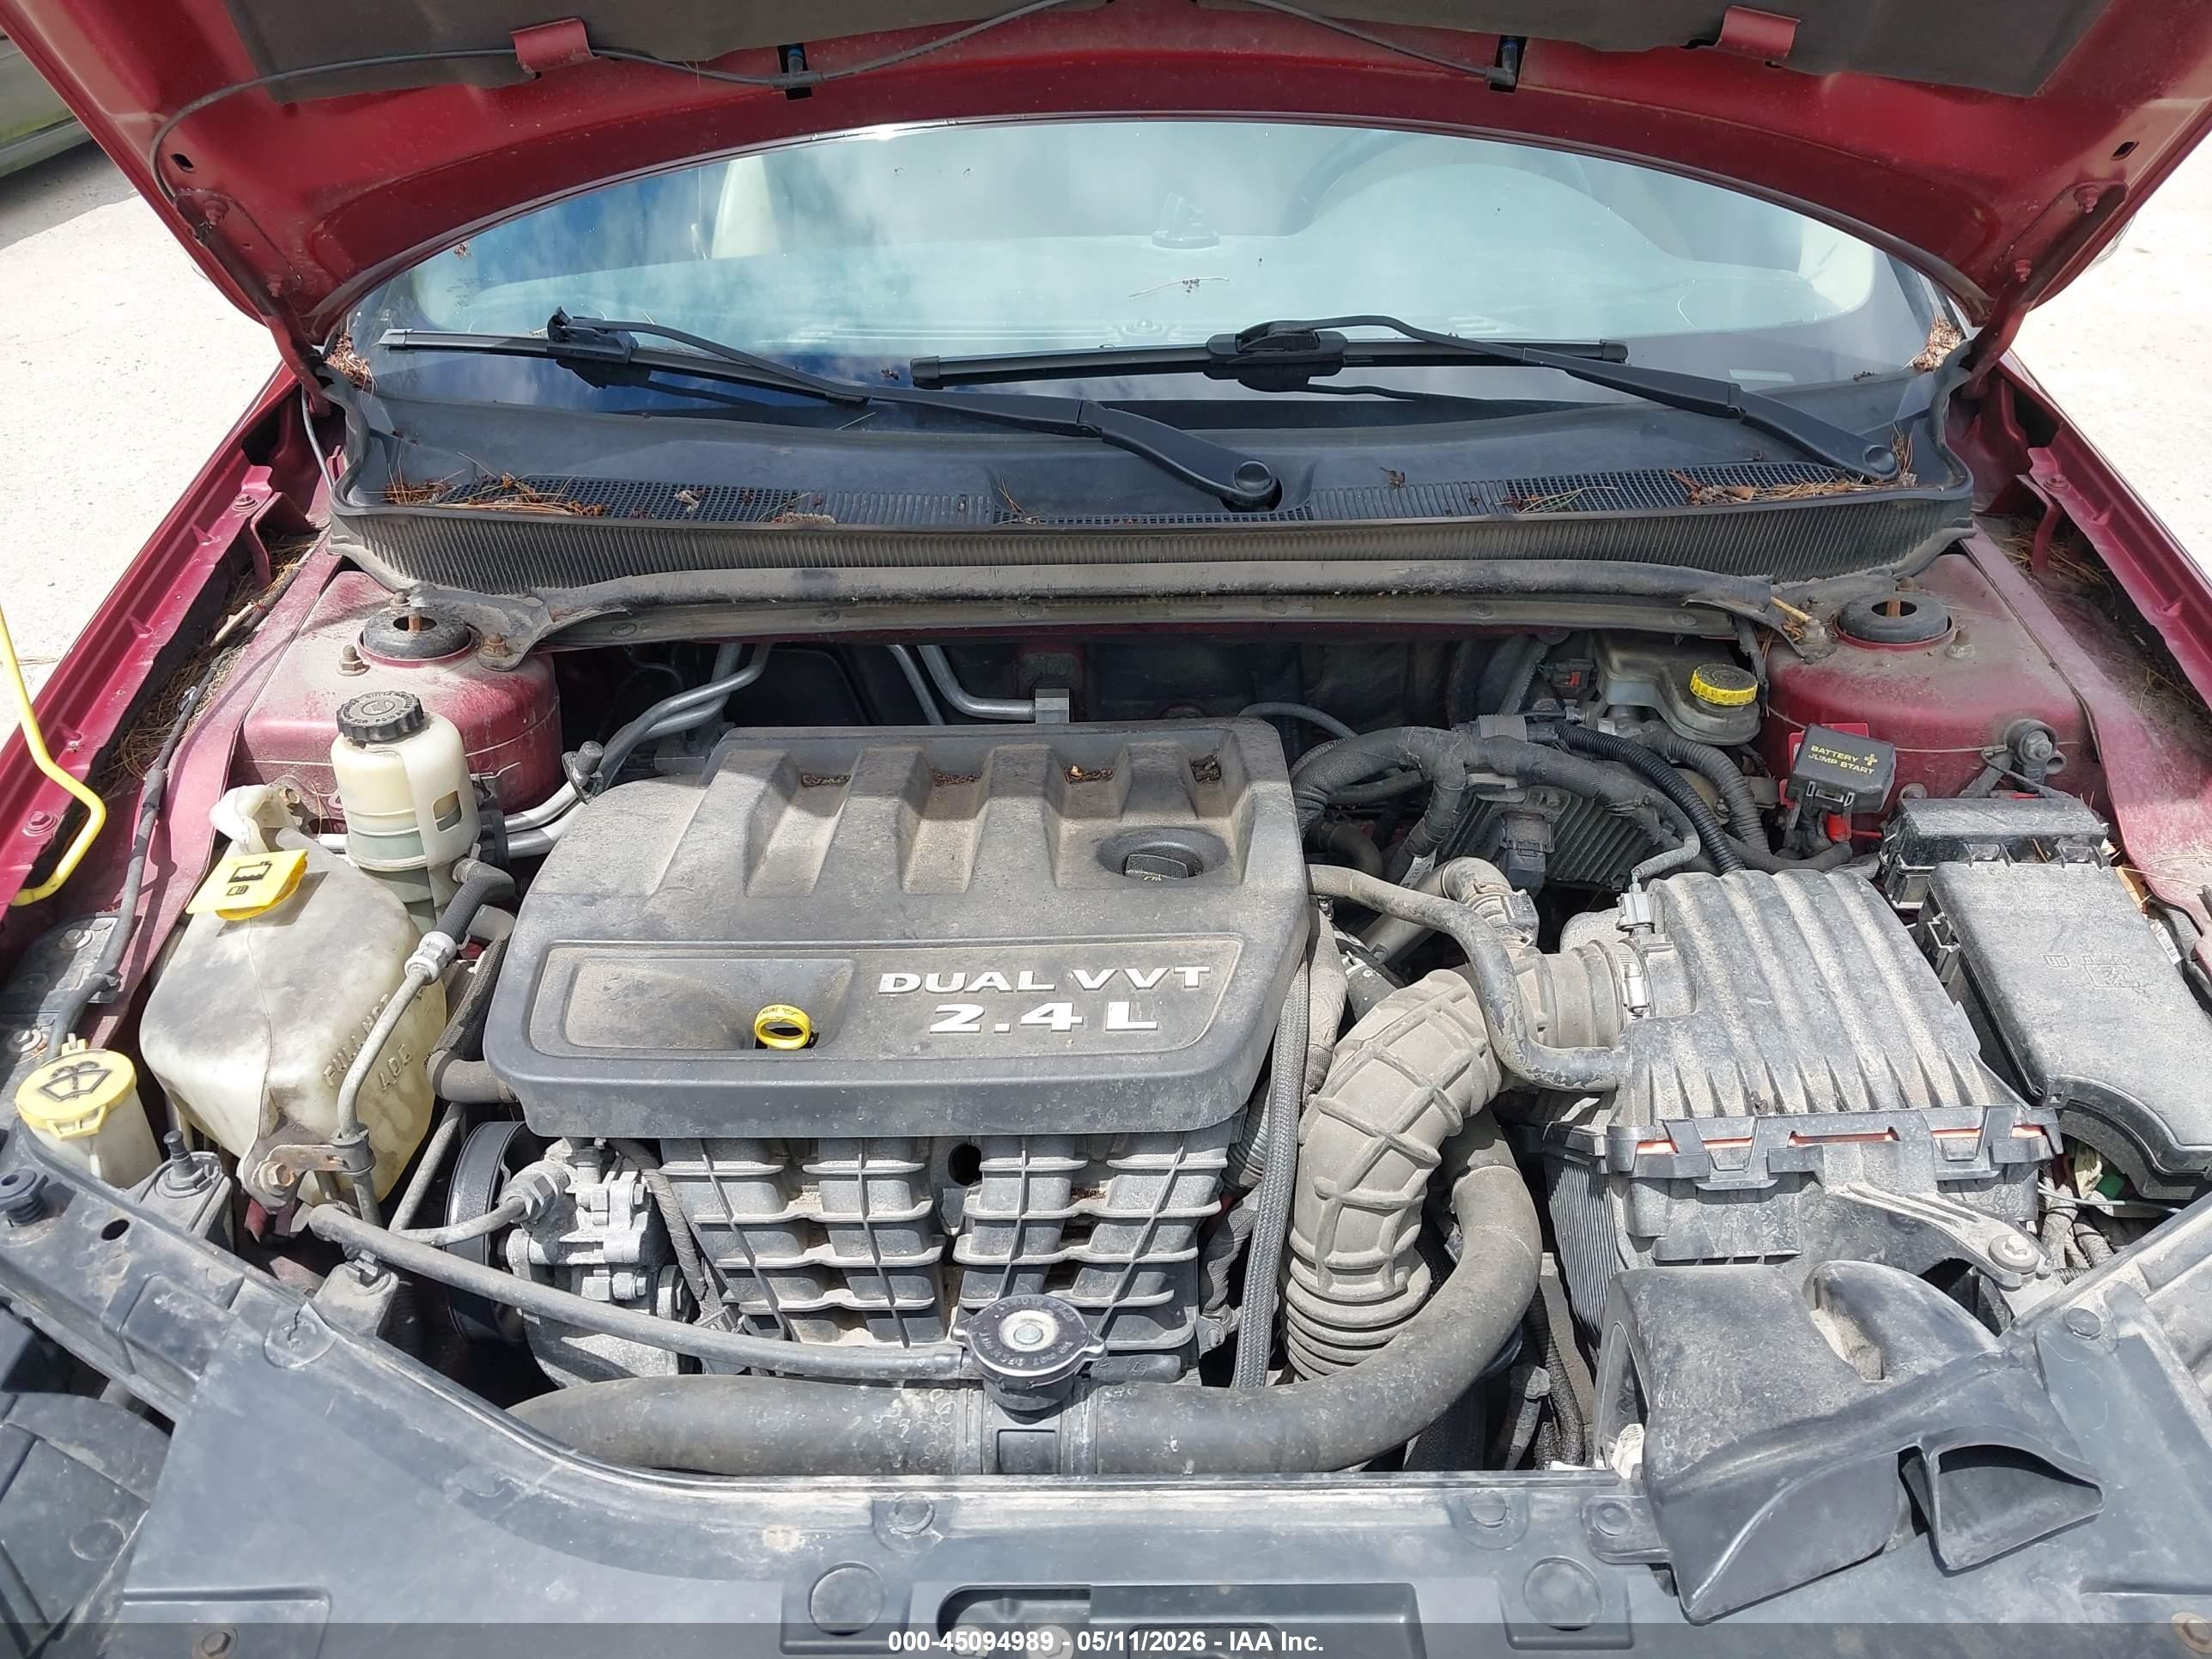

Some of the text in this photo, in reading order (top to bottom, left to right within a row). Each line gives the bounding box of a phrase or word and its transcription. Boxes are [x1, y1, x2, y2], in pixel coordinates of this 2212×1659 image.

[1808, 753, 1875, 775] JUMP START
[1811, 745, 1859, 762] BATTERY
[878, 966, 1211, 994] DUAL VVT
[929, 1001, 1158, 1034] 2.4 L
